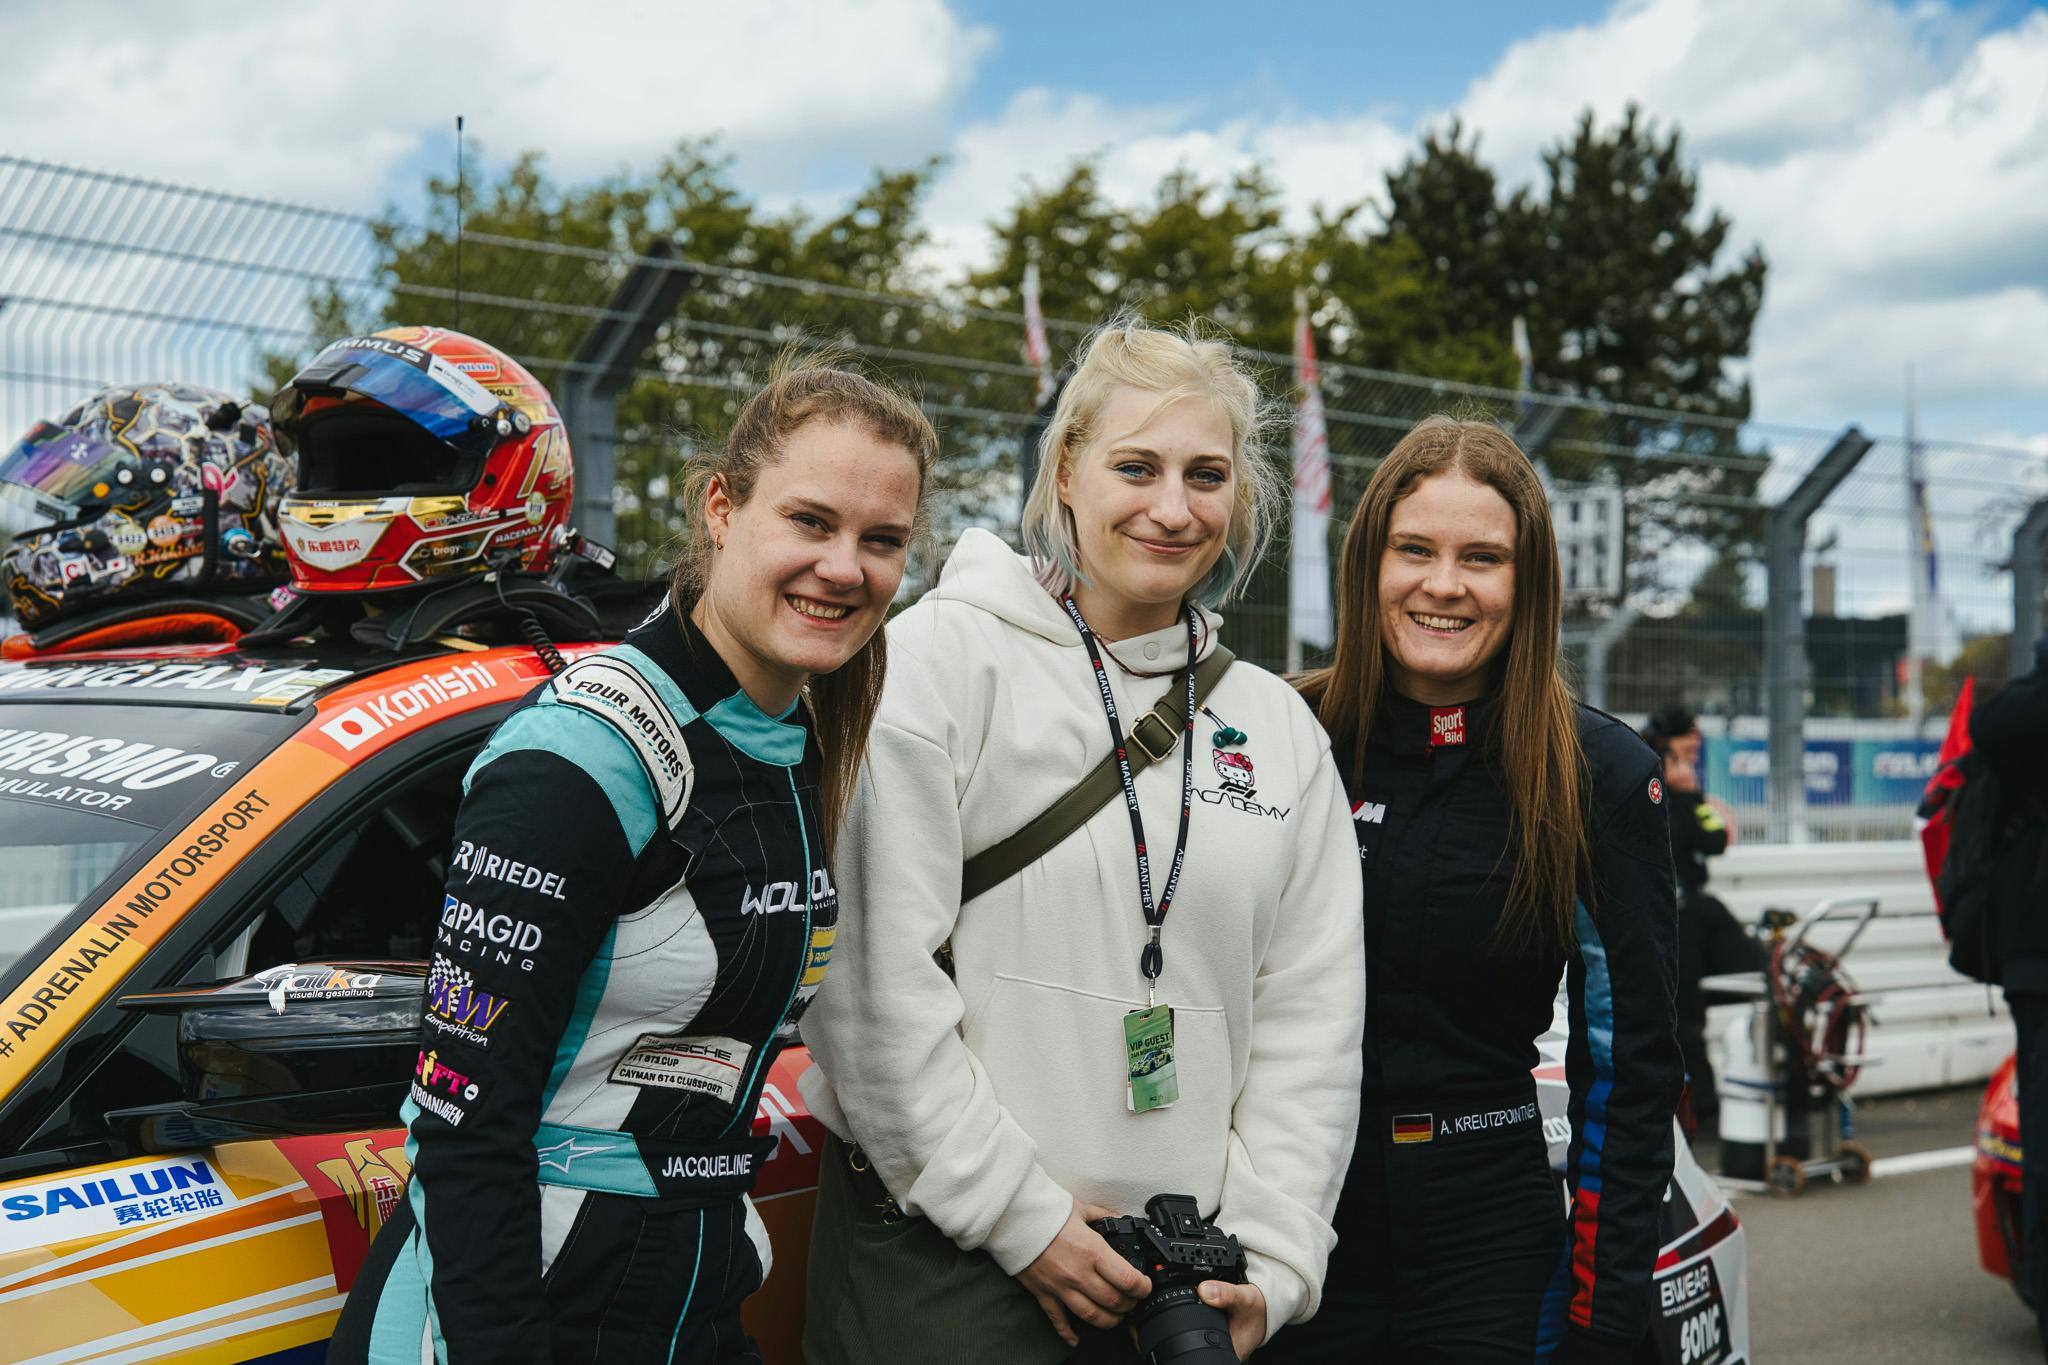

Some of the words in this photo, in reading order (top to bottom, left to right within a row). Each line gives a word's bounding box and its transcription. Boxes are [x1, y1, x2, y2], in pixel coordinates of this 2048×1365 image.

[496, 526, 544, 544] RACEMAX
[1065, 599, 1089, 634] MANTHEY
[366, 660, 498, 729] Konishi
[1097, 669, 1117, 720] MANTHEY
[1188, 673, 1196, 721] MANTHEY
[574, 680, 630, 708] FOUR
[629, 704, 683, 778] MOTORS
[1433, 708, 1463, 736] Sport
[1445, 731, 1463, 744] Bild
[1120, 760, 1139, 812] MANTHEY
[1184, 759, 1193, 807] MANTHEY
[483, 853, 567, 901] RIEDEL
[1138, 856, 1153, 910] MANTHEY
[1165, 848, 1185, 901] MANTHEY
[6, 913, 139, 1042] ADRENALIN
[125, 788, 271, 918] MOTORSPORT
[740, 881, 806, 916] WOL
[454, 902, 543, 953] PAGID
[289, 989, 324, 999] visuelle
[325, 988, 375, 999] gestaltung
[430, 975, 510, 1032] KW
[424, 1012, 489, 1047] competition
[1129, 1040, 1143, 1052] VIP
[1144, 1032, 1170, 1047] GUEST
[619, 1068, 656, 1082] CAYMAN
[657, 1072, 675, 1084] GT4
[676, 1075, 722, 1096] CLUBSPORT
[661, 1057, 680, 1068] CUP
[1440, 1119, 1453, 1136] A.
[1455, 1102, 1537, 1134] KREUTZPOINTNER
[661, 1153, 753, 1179] JACQUELINE
[1, 1160, 215, 1222] SAILUN
[113, 1188, 224, 1226] 赛轮轮胎
[1660, 1264, 1711, 1308] BWEAR
